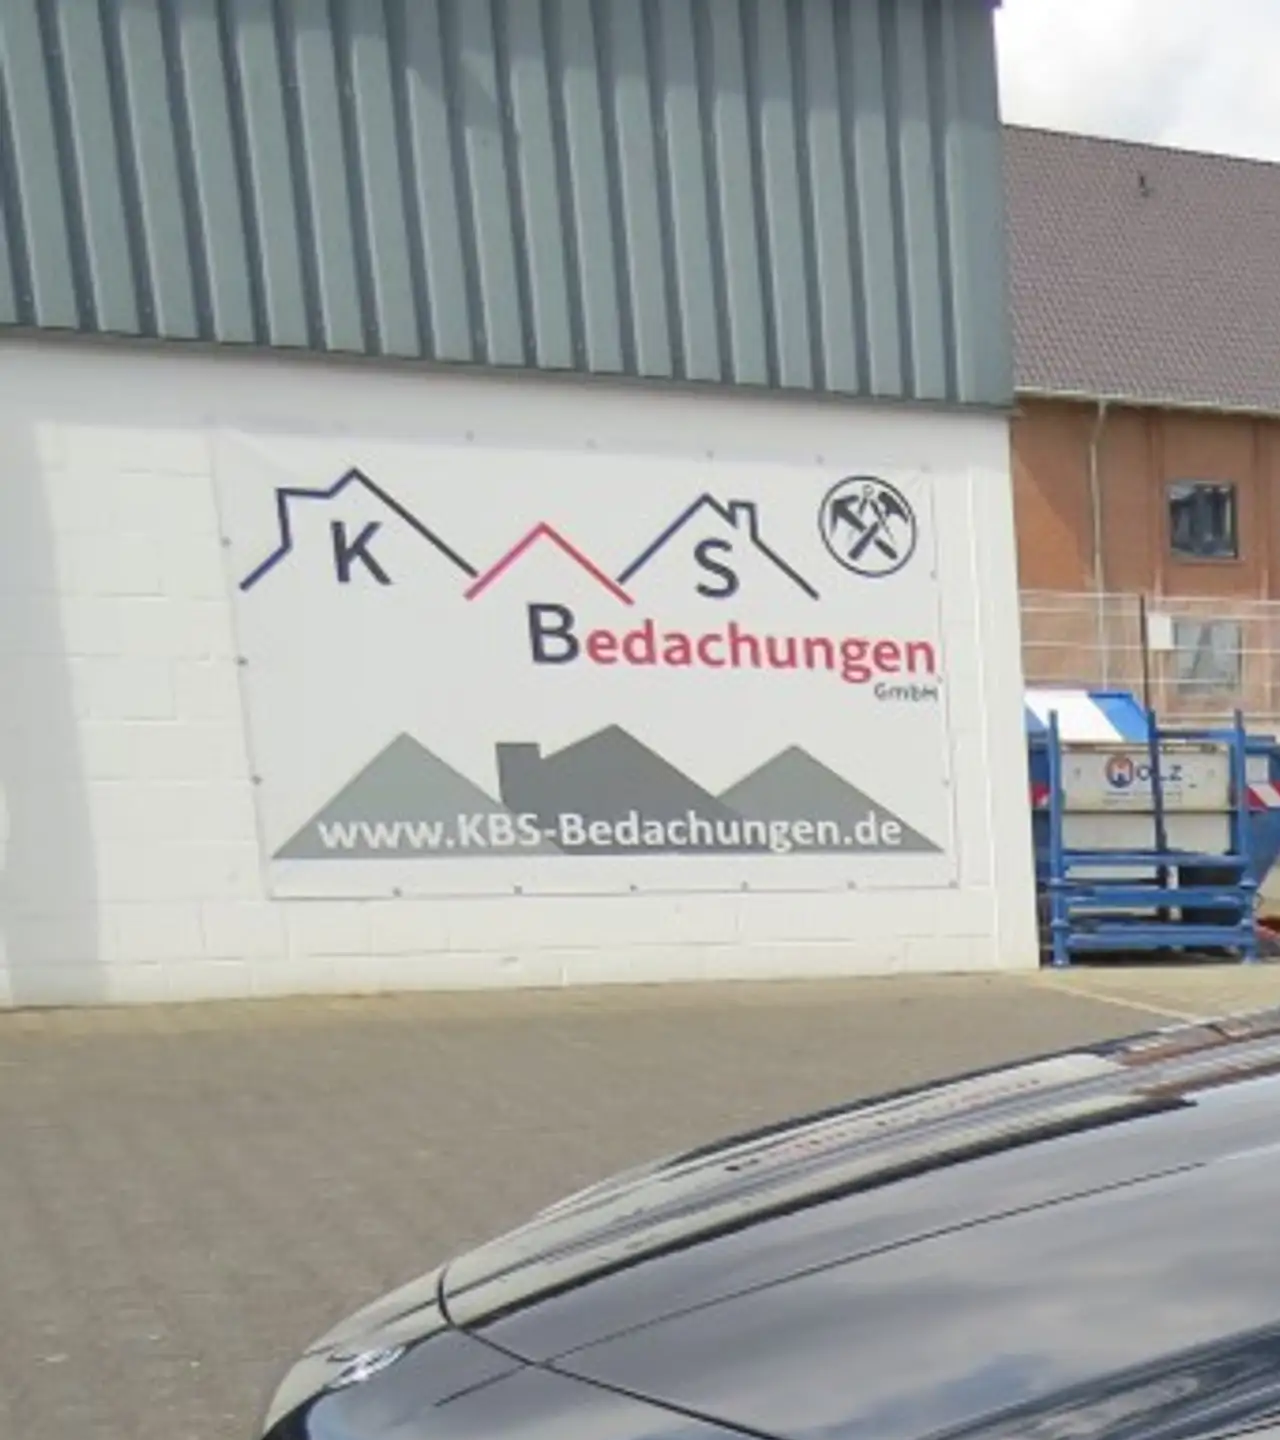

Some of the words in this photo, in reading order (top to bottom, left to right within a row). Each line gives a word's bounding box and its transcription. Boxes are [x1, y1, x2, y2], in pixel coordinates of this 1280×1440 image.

[330, 520, 392, 586] K
[693, 538, 740, 600] S
[527, 602, 937, 683] Bedachungen
[873, 682, 939, 703] GmbH
[318, 808, 903, 855] www.KBS-Bedachungen.de
